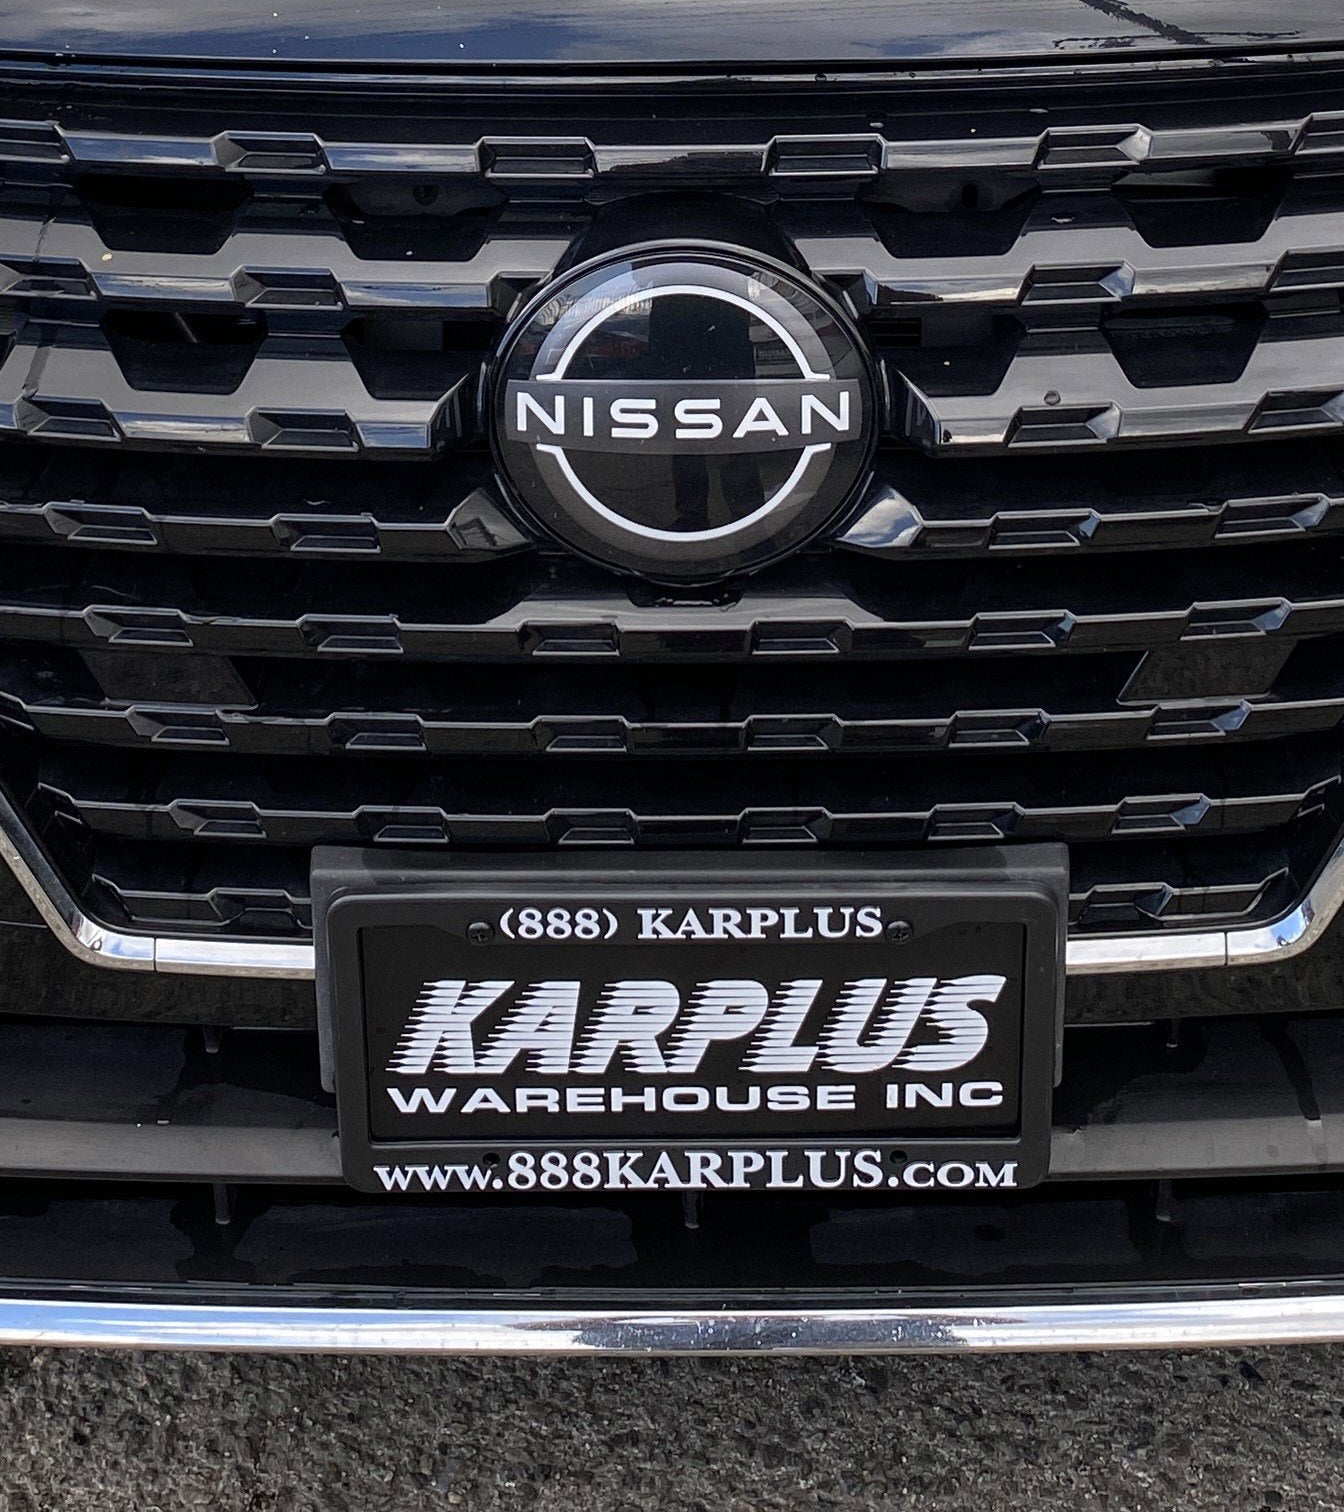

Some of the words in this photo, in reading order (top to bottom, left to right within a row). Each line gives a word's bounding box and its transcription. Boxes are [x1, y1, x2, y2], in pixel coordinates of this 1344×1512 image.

[516, 390, 850, 440] NISSAN
[499, 907, 618, 940] (888)
[637, 906, 883, 940] KARPLUS
[385, 974, 1007, 1075] KARPLUS
[386, 1085, 856, 1114] WAREHOUSE
[886, 1081, 1004, 1109] INC
